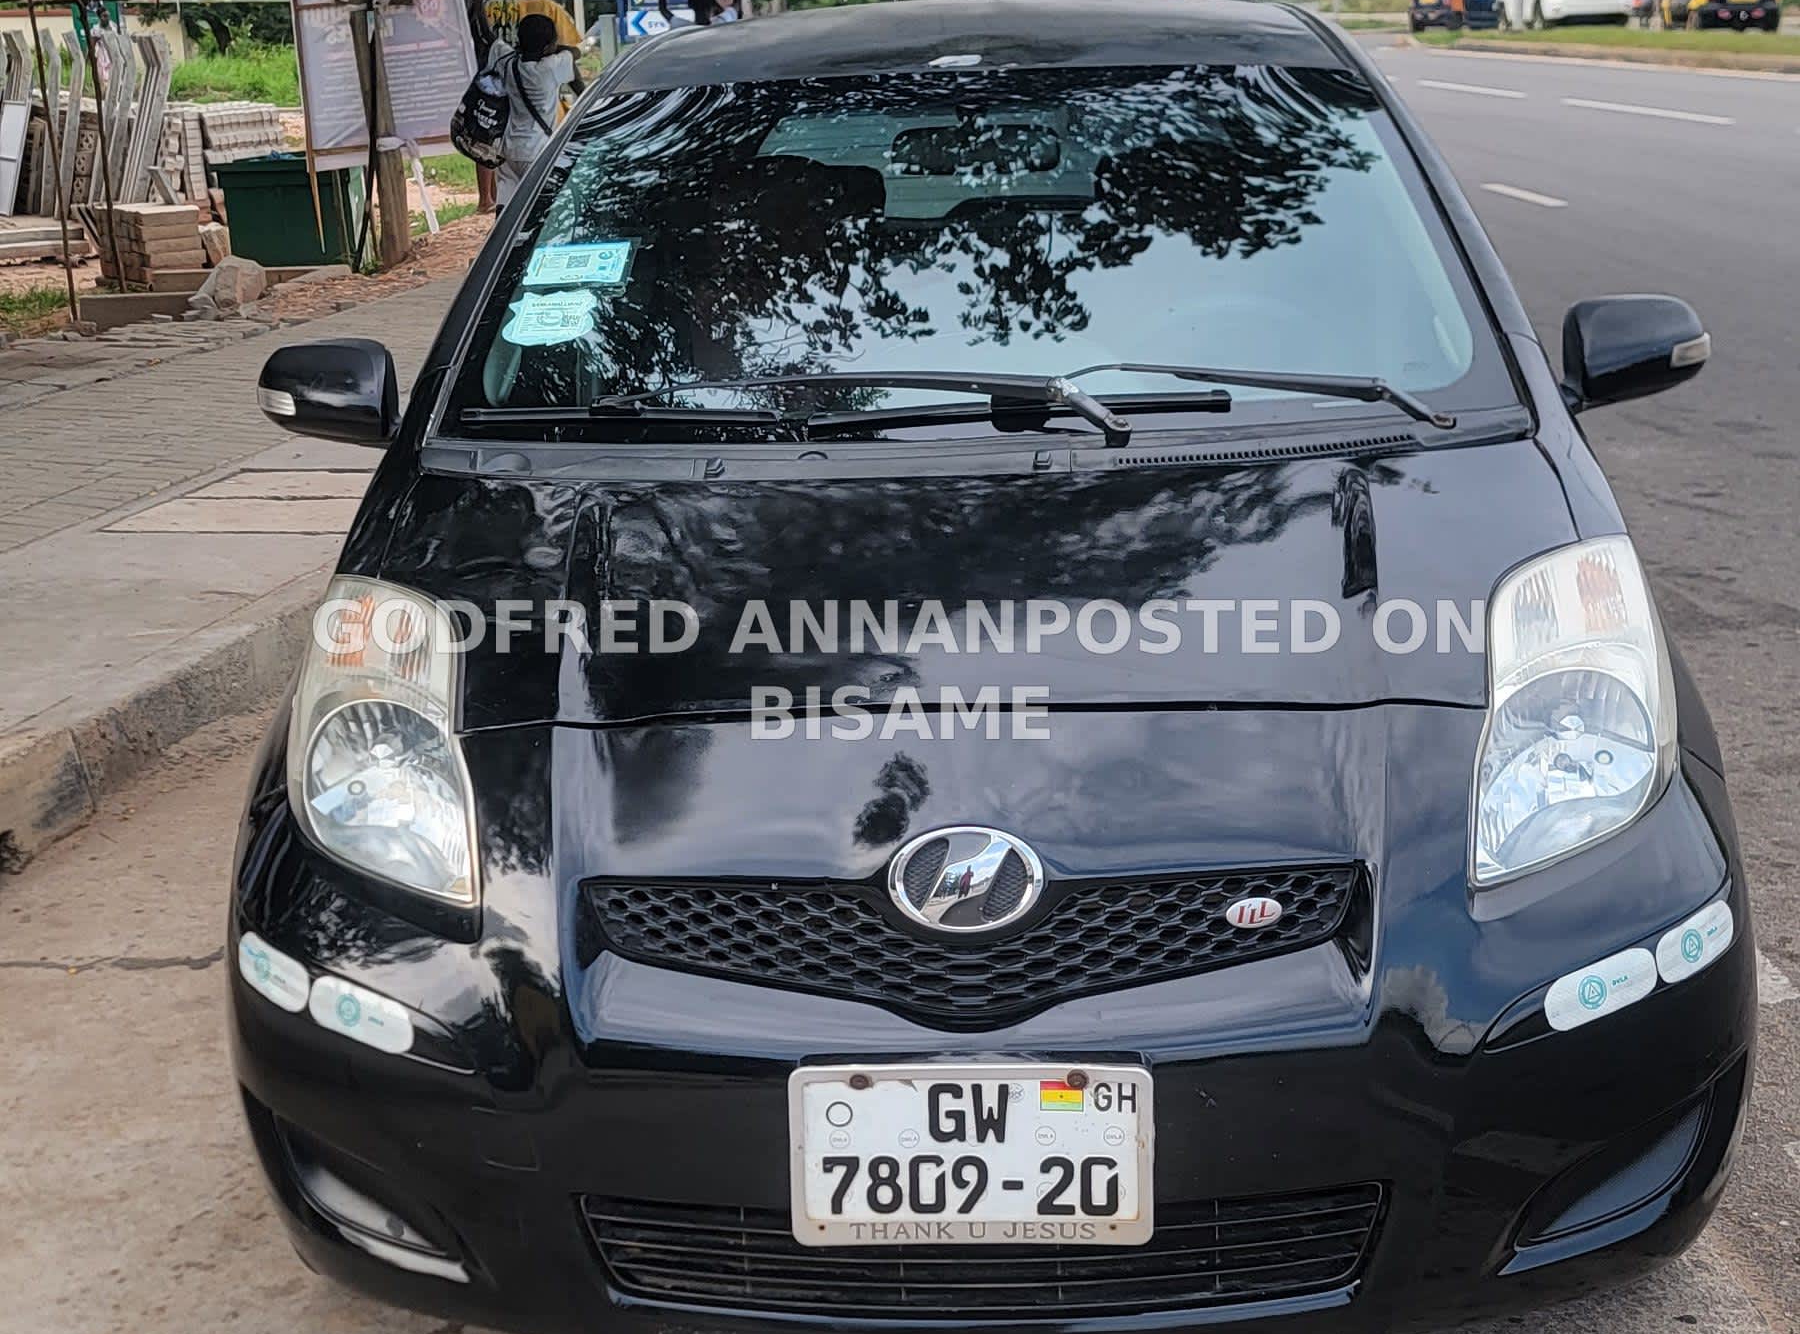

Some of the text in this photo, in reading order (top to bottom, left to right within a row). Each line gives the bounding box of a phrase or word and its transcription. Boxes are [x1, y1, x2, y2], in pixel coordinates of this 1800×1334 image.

[928, 1082, 1137, 1144] GW GH
[822, 1154, 1120, 1217] 7809-20
[850, 1221, 1098, 1240] THANK U JESUS
